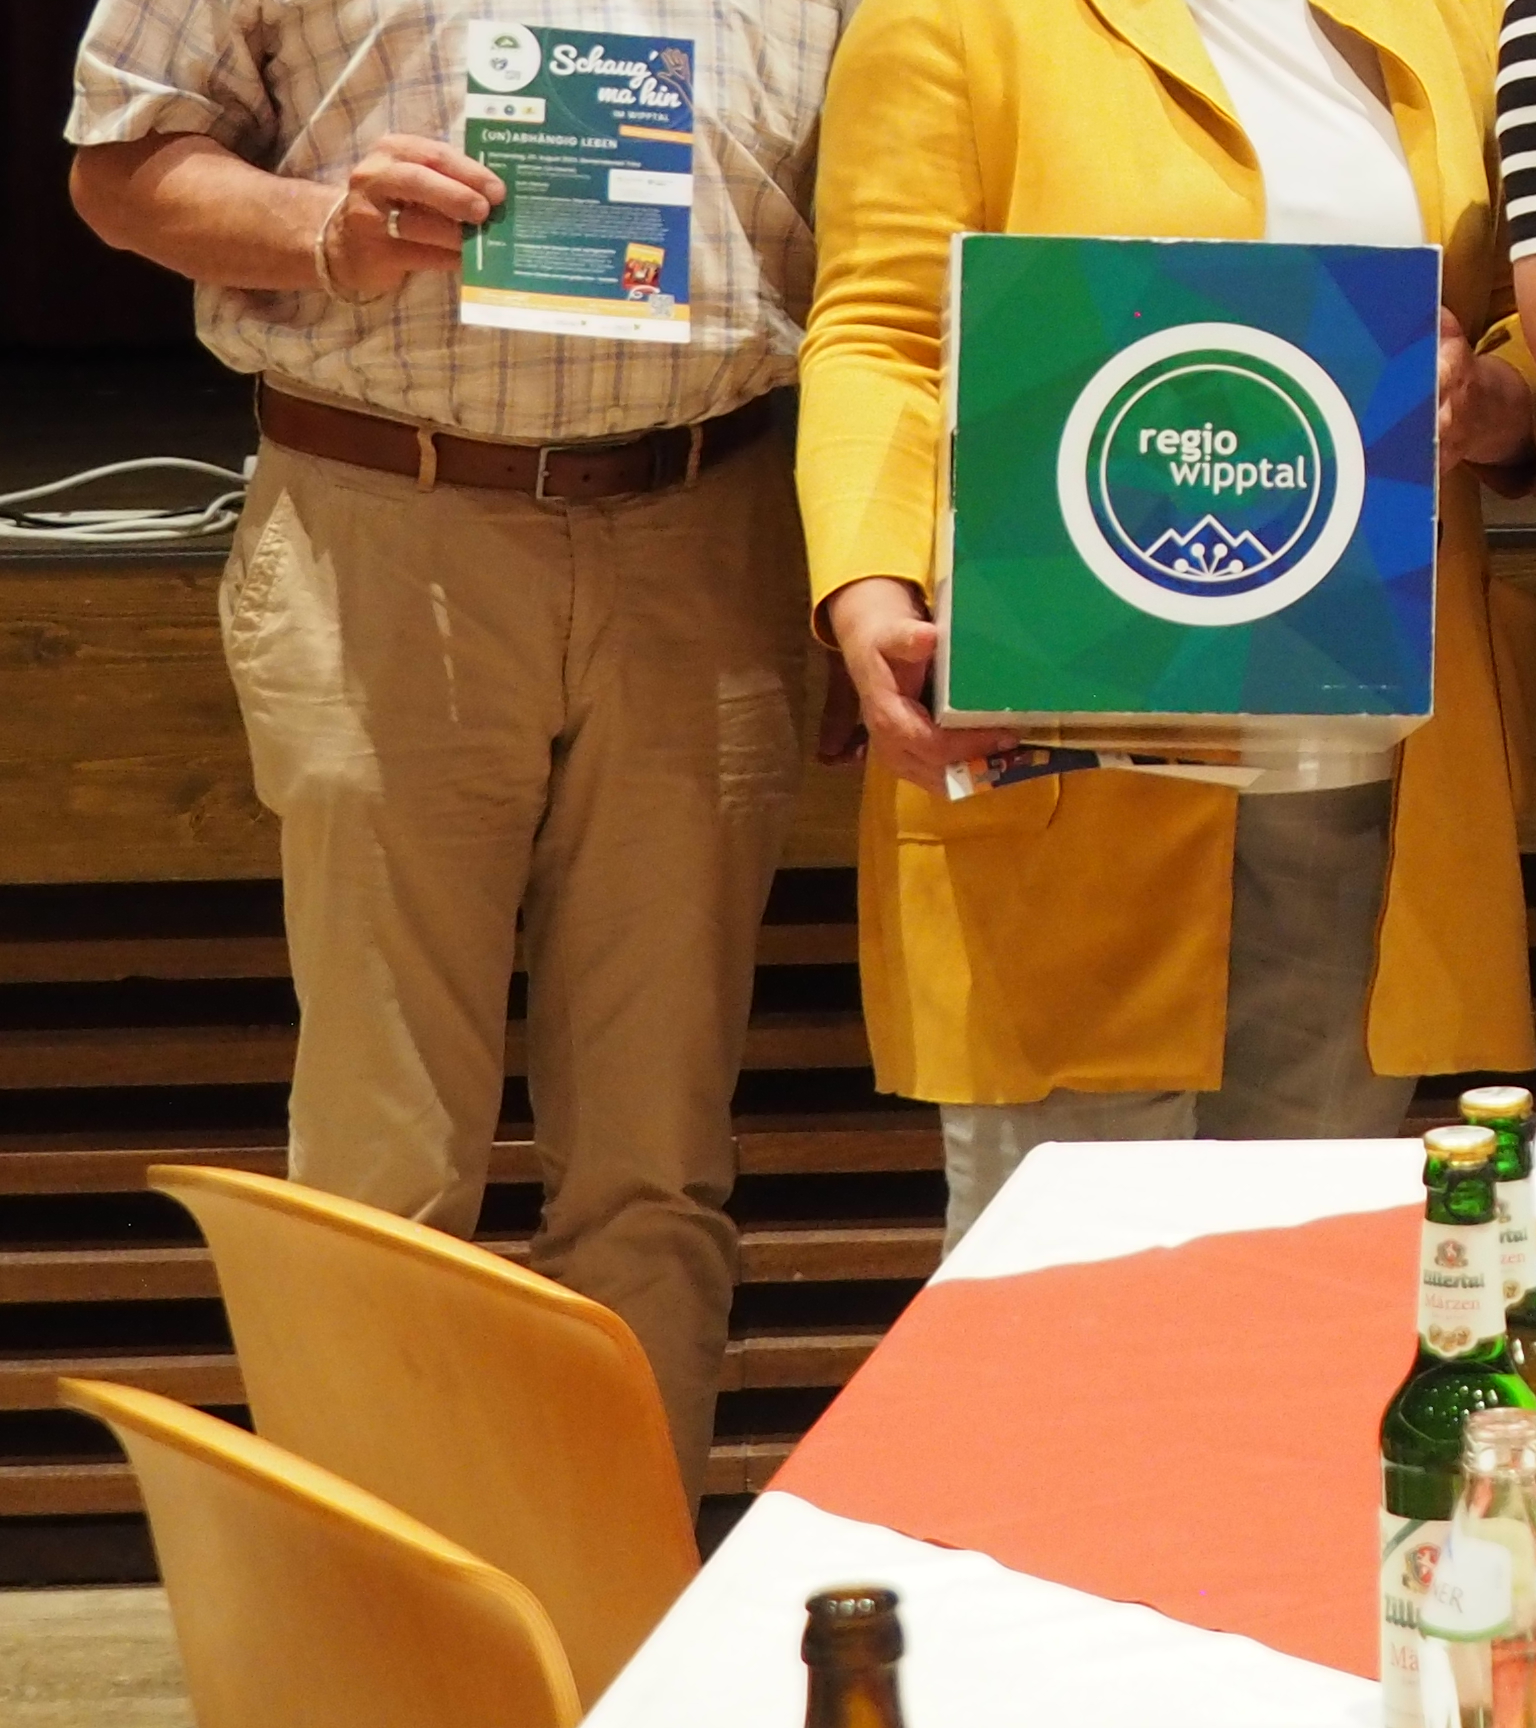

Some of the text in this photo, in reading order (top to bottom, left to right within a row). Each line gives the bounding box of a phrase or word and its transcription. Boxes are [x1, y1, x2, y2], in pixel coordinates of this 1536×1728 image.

[597, 77, 682, 108] ma hin
[1139, 421, 1238, 463] regio
[1170, 455, 1308, 495] wipptal
